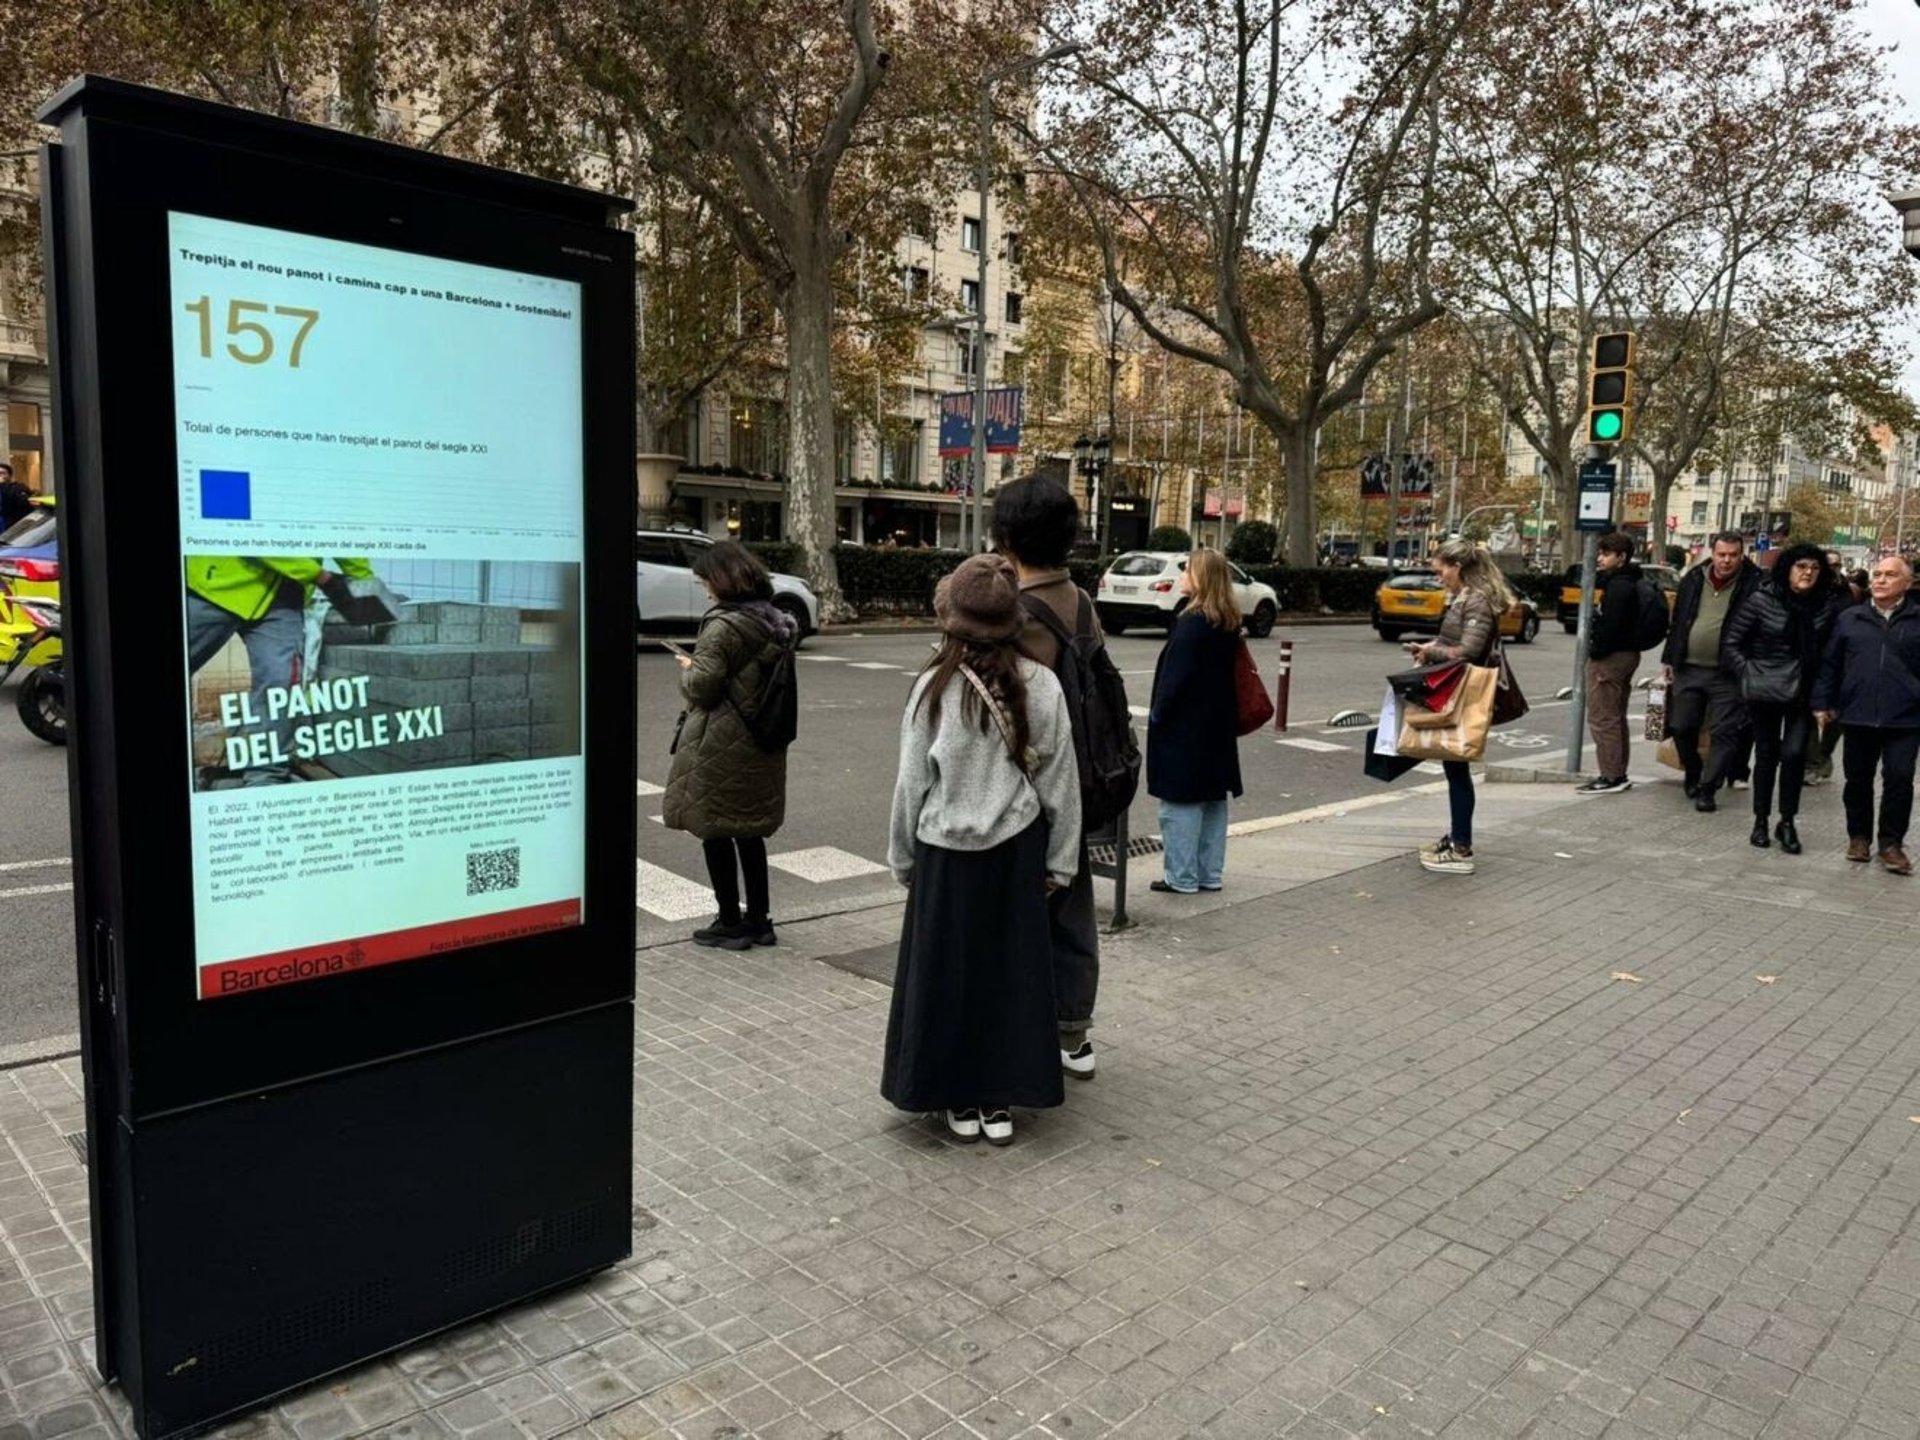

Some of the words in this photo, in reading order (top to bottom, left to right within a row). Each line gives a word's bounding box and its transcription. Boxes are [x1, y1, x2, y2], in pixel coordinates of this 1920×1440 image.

[179, 248, 236, 268] Trepitja
[239, 259, 254, 270] el
[256, 263, 283, 275] nou
[285, 267, 324, 281] panot
[328, 272, 331, 282] i
[335, 275, 382, 290] camina
[384, 283, 407, 295] cap
[410, 287, 418, 296] a
[420, 289, 443, 300] una
[445, 290, 502, 309] Barcelona
[514, 303, 571, 320] sostenible!
[184, 295, 320, 368] 157
[182, 419, 213, 434] Total
[215, 424, 232, 435] de
[234, 426, 289, 440] persones
[290, 431, 313, 442] que
[315, 431, 337, 443] han
[338, 433, 379, 448] trepitjat
[380, 437, 391, 447] el
[392, 439, 422, 449] panot
[423, 440, 440, 451] del
[441, 442, 468, 454] segle
[470, 443, 488, 454] XXI
[185, 535, 230, 546] Persones
[232, 539, 250, 547] que
[251, 538, 269, 547] han
[270, 538, 302, 549] trepitjat
[303, 540, 312, 548] el
[313, 540, 338, 549] panot
[339, 540, 353, 549] del
[353, 541, 376, 551] segle
[377, 540, 392, 549] XXI
[220, 691, 261, 727] EL
[266, 675, 370, 721] PANOT
[225, 731, 289, 771] DEL
[294, 713, 390, 759] SEGLE
[394, 706, 444, 743] XXI
[220, 954, 343, 993] Barcelona
